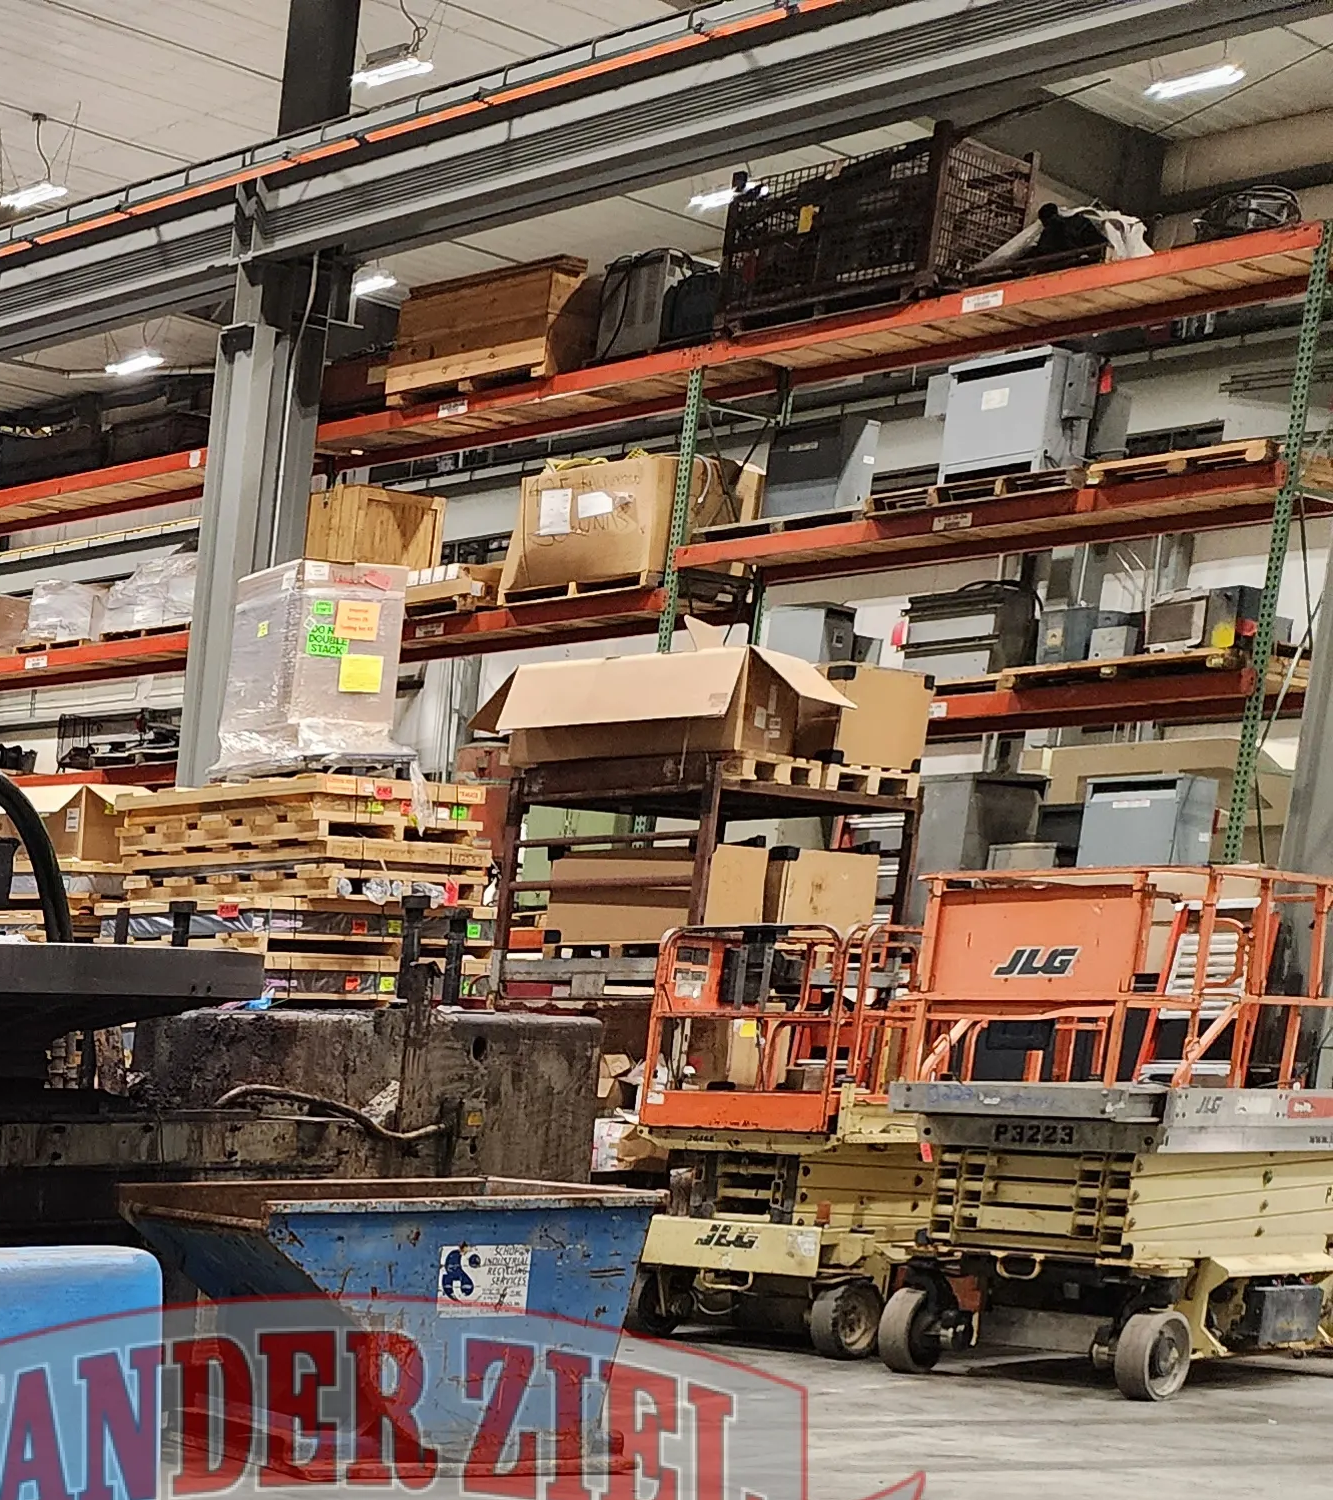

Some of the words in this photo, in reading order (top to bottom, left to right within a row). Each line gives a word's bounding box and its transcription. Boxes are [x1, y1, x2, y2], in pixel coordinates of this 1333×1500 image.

[308, 634, 348, 646] DOUBLE
[311, 644, 343, 655] STACK
[993, 947, 1079, 976] JLG
[1194, 1096, 1224, 1114] JLG
[994, 1123, 1075, 1144] P3223
[694, 1223, 760, 1249] JLG
[484, 1256, 529, 1267] INDUSTRIAL
[486, 1266, 528, 1276] RECYCLING
[491, 1276, 527, 1287] SERVICES
